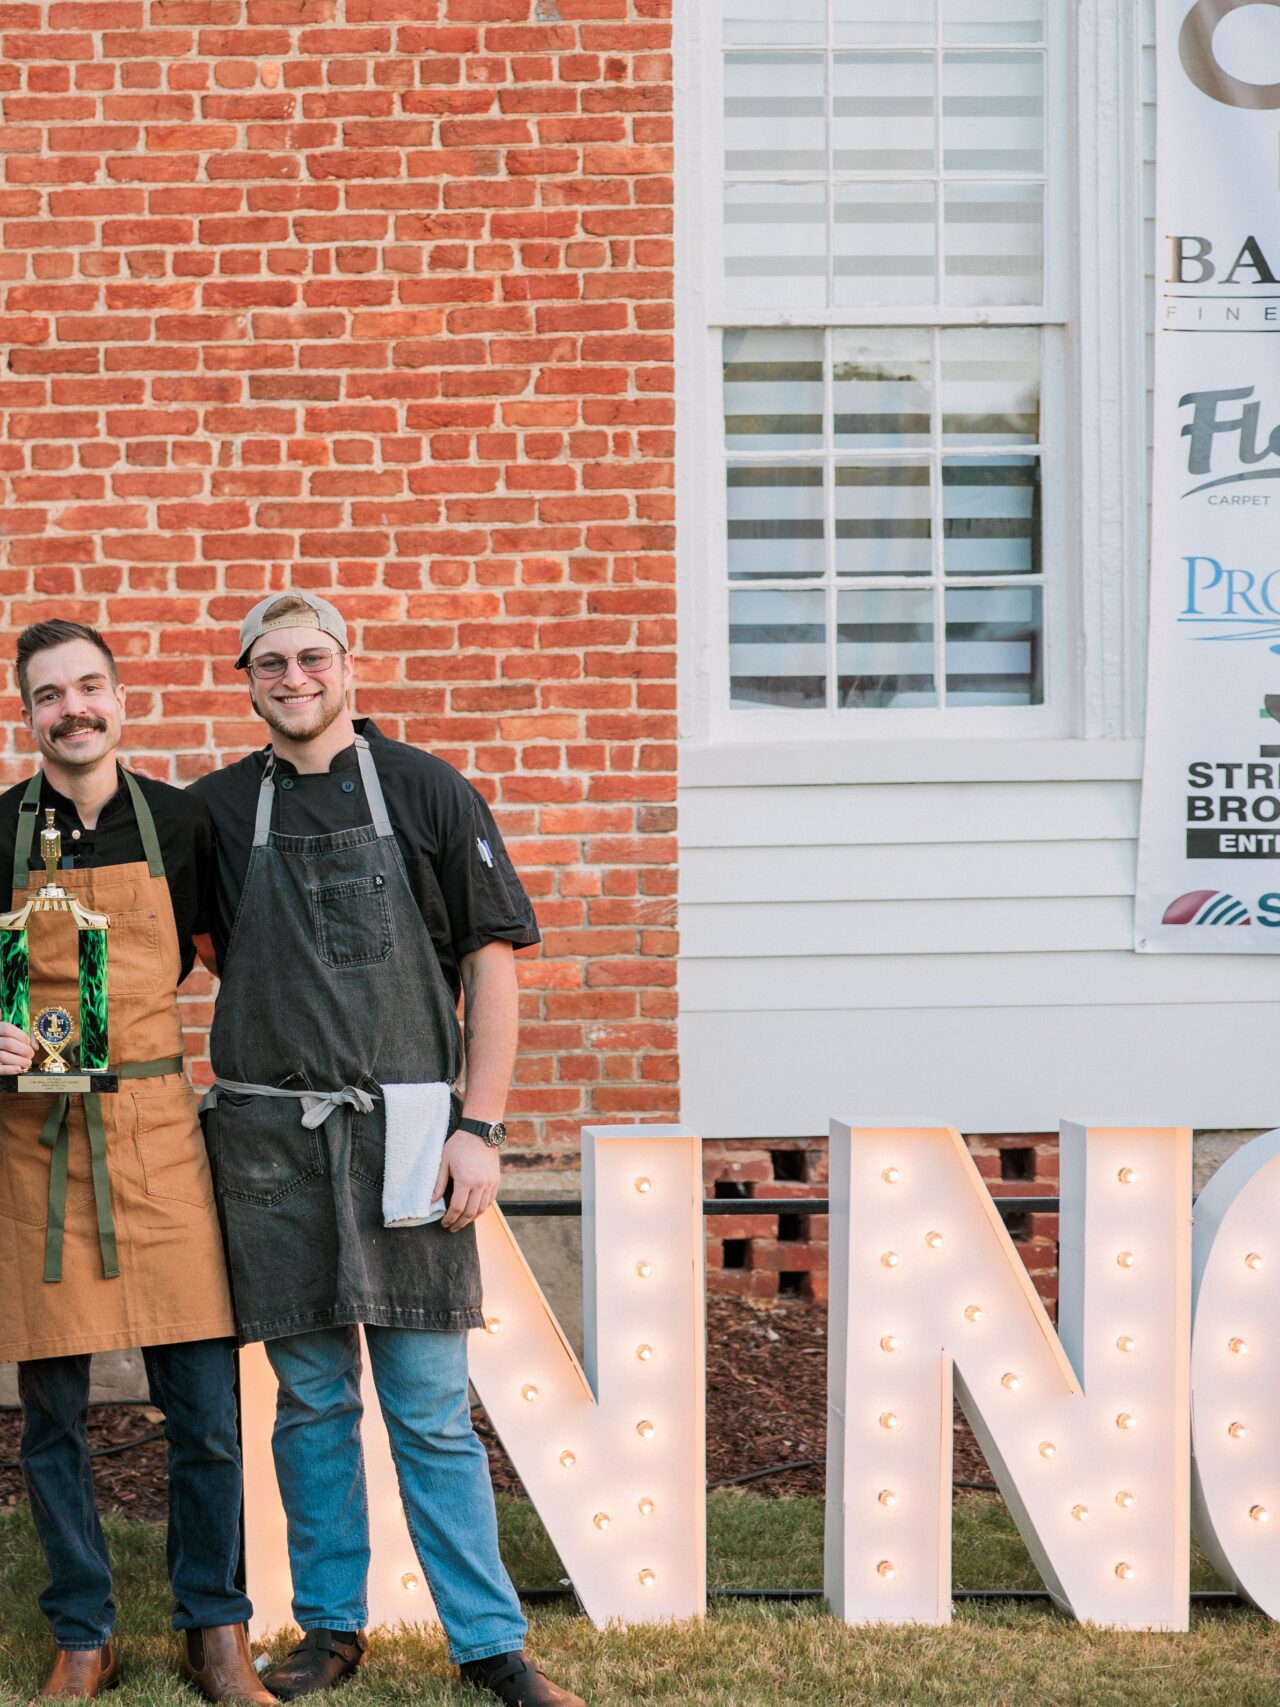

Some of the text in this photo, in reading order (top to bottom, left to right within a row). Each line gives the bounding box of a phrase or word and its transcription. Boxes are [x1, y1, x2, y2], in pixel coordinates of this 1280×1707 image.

[1165, 235, 1280, 284] BA
[1166, 306, 1278, 321] FINE
[1207, 495, 1271, 506] CARPET
[1187, 762, 1280, 789] STR
[1186, 795, 1280, 822] BRO
[1219, 834, 1280, 853] ENT
